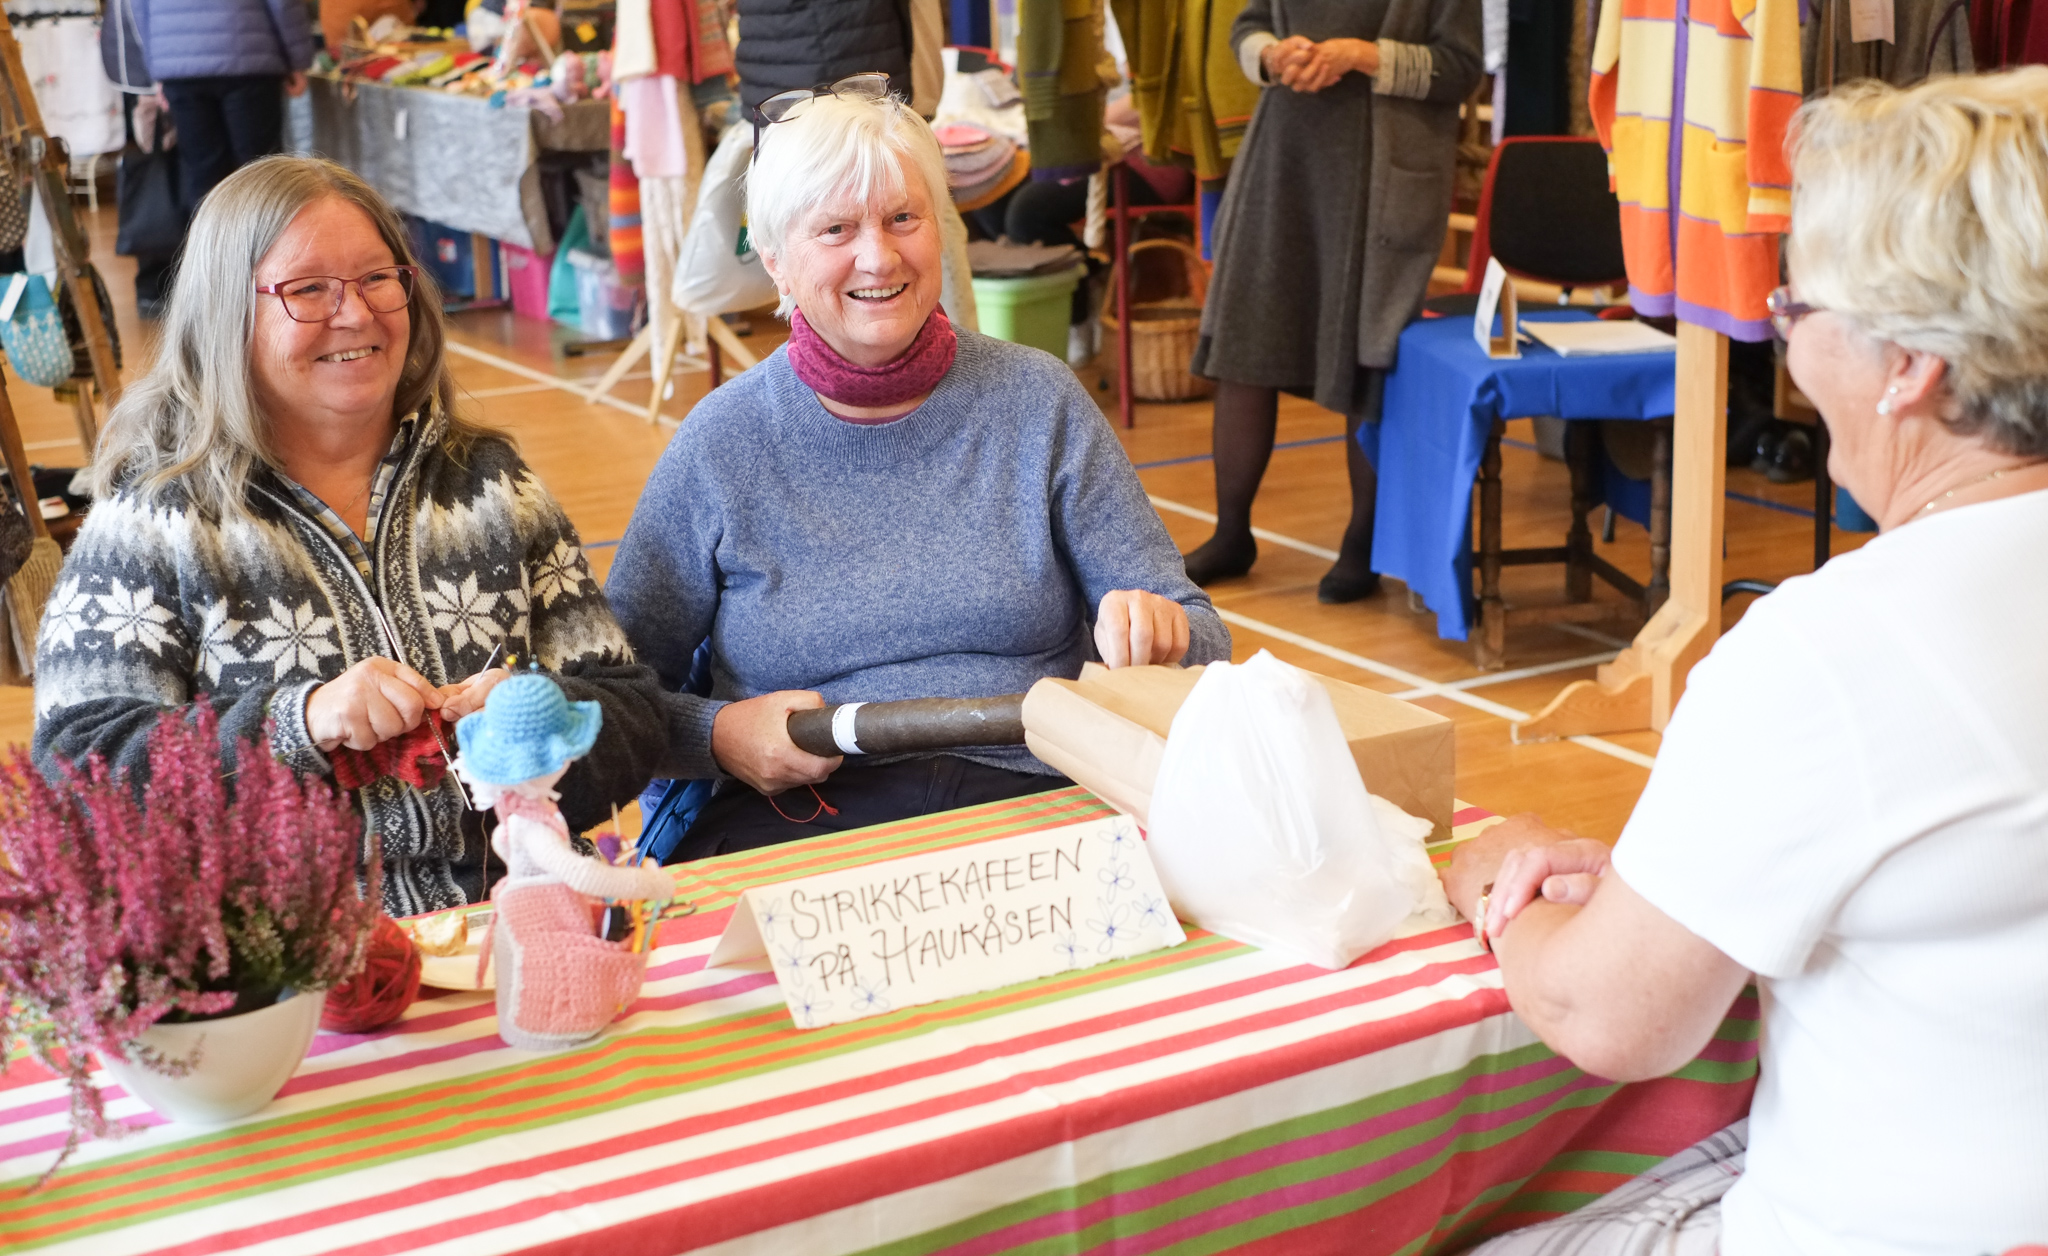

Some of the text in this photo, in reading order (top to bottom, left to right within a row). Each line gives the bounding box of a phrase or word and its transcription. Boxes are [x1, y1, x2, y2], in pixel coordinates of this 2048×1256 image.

[791, 839, 1082, 939] STRIKKEKAFEEN
[810, 897, 1072, 990] PÅ HAUKÅSEN
